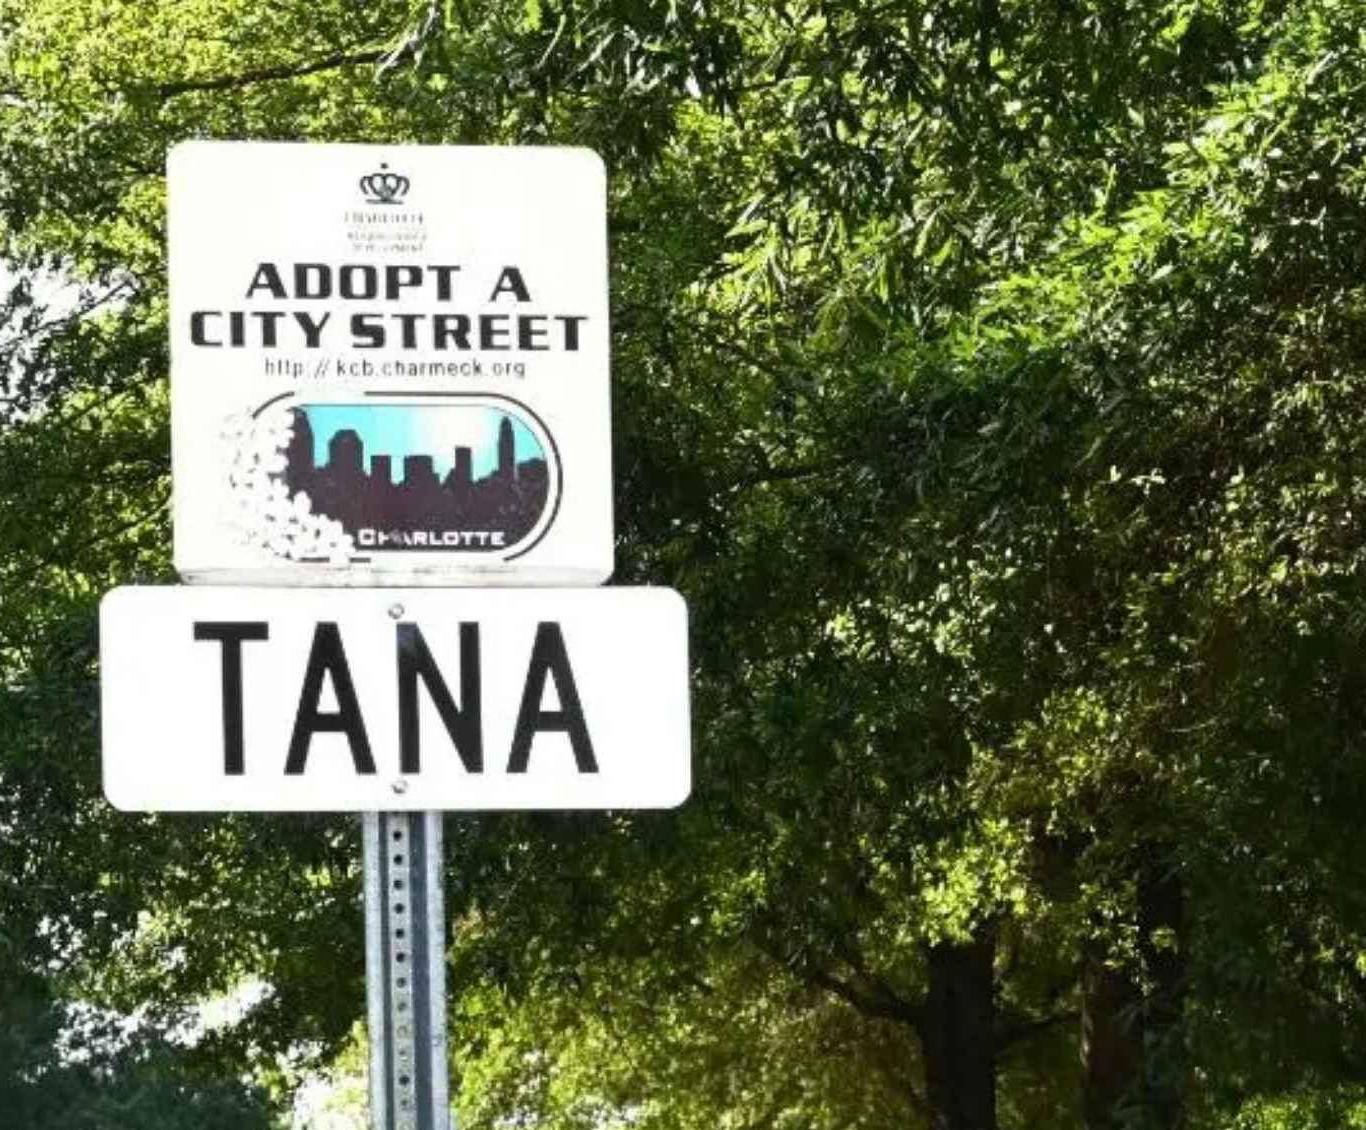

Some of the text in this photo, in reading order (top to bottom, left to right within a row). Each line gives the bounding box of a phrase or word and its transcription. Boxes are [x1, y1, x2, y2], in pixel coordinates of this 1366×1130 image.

[245, 262, 532, 302] ADOPT A
[189, 311, 590, 352] CITY STREET
[193, 621, 600, 776] TANA
